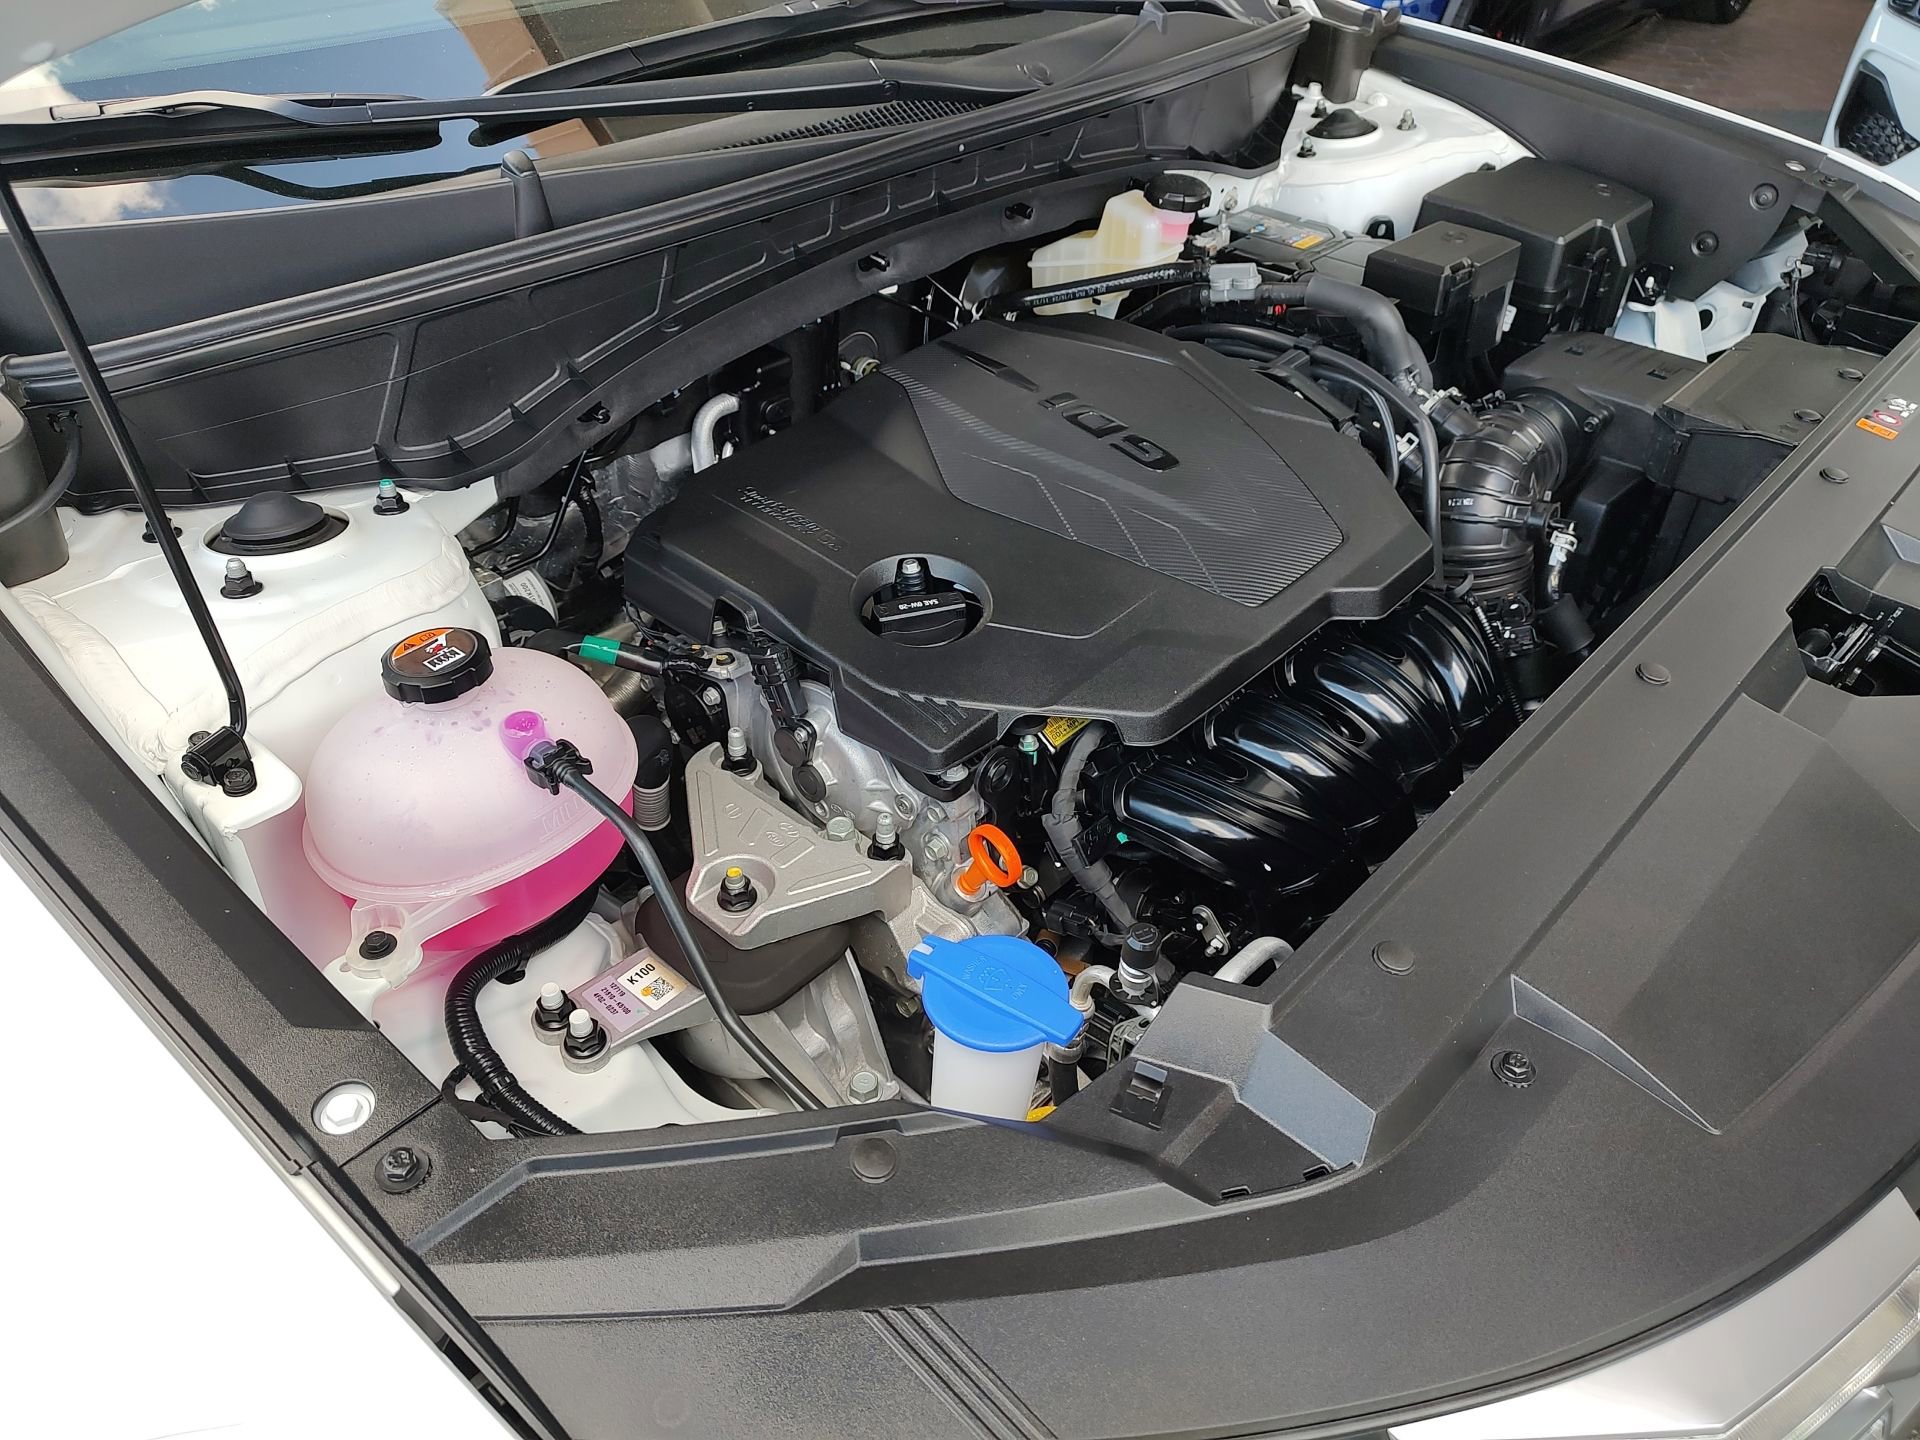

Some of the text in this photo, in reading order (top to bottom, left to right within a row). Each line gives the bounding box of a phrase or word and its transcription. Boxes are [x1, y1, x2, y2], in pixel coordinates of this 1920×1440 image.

[898, 598, 939, 611] SAE 0W-20
[626, 963, 656, 986] K100
